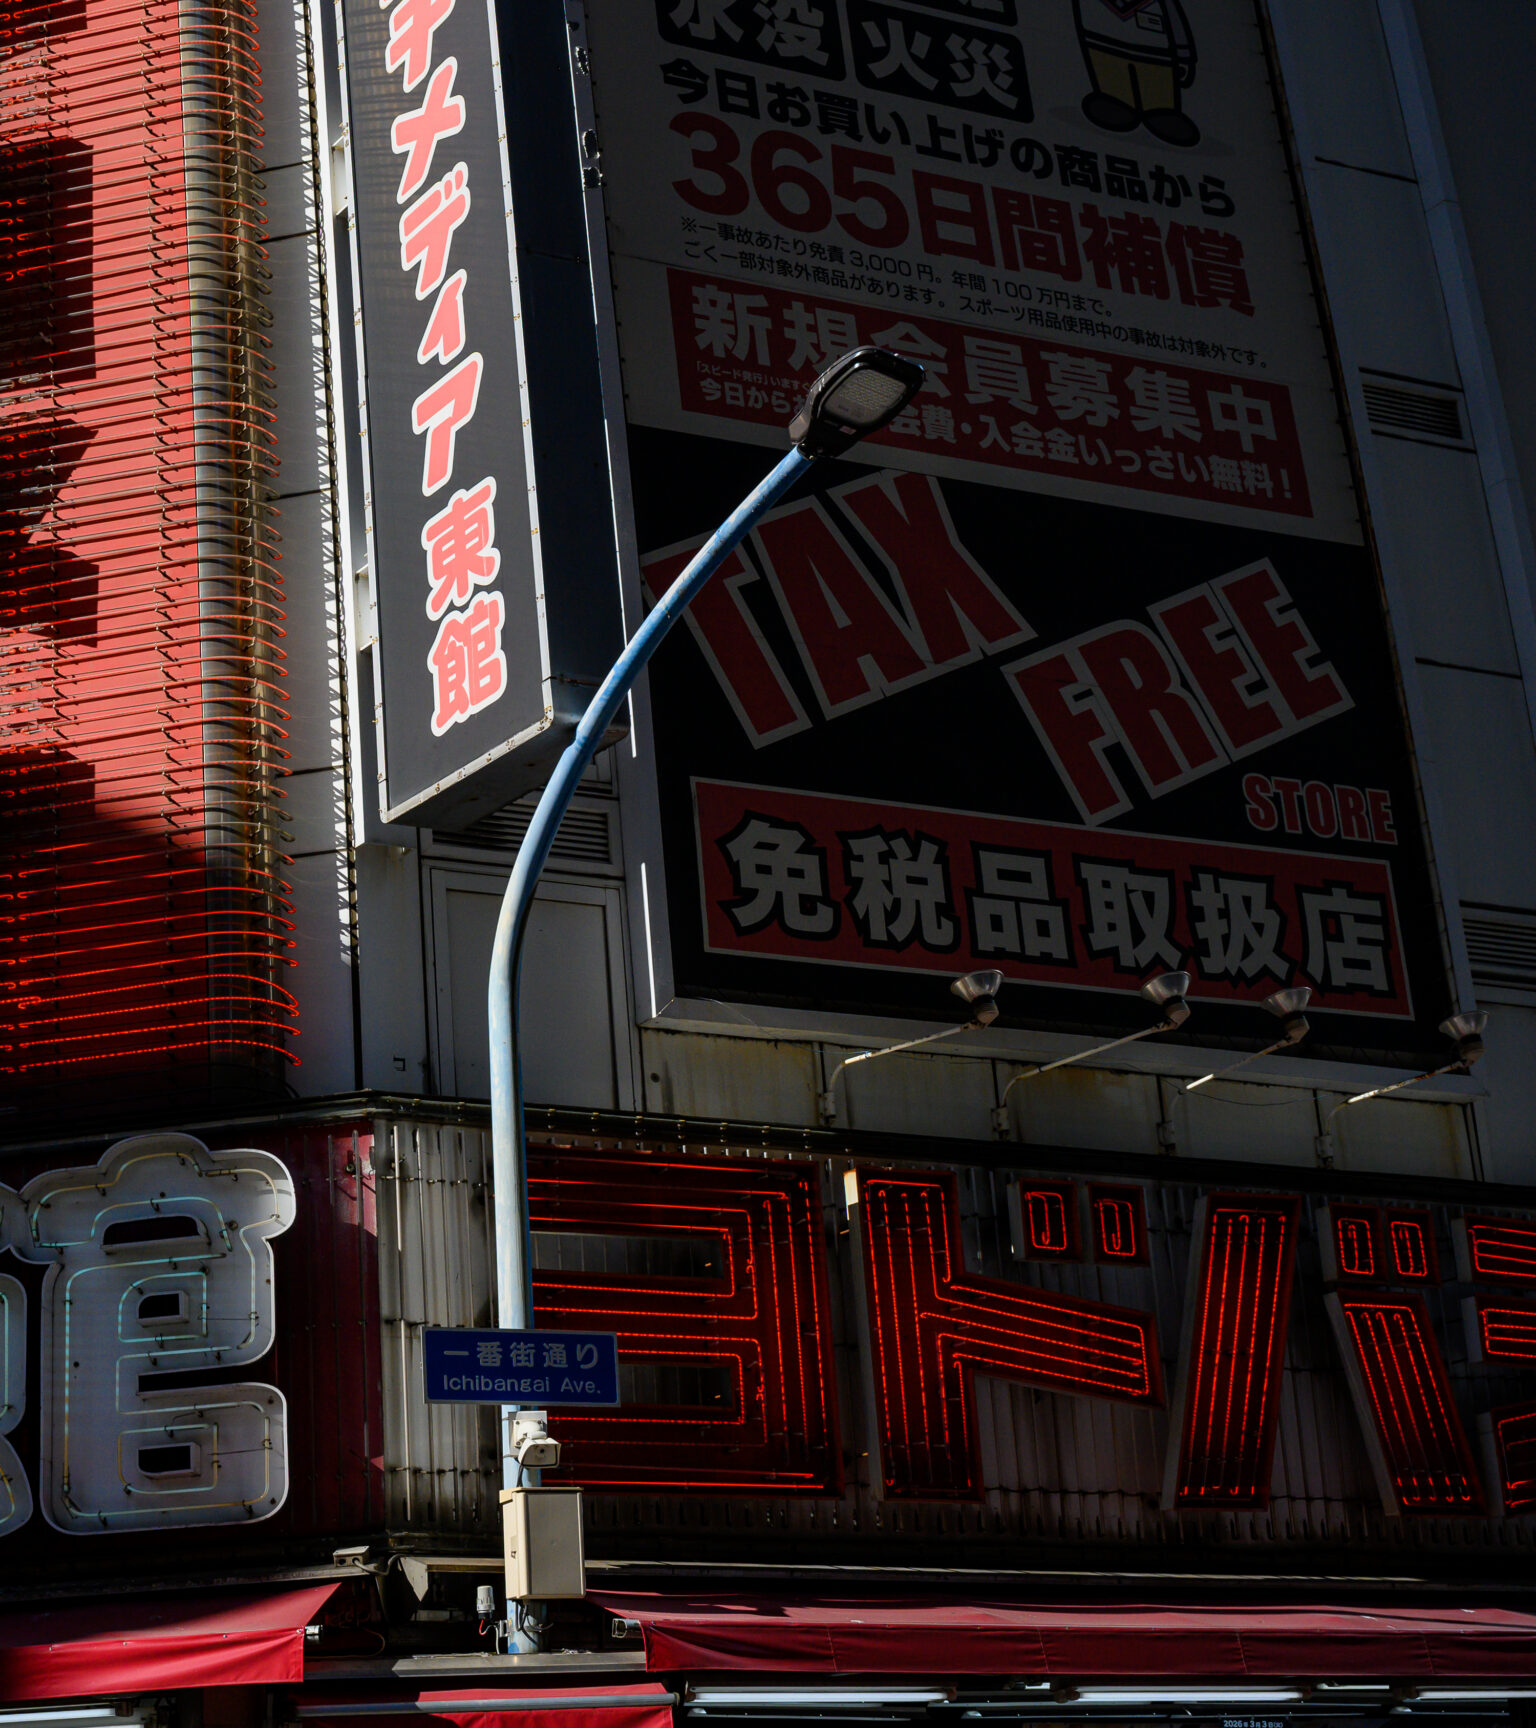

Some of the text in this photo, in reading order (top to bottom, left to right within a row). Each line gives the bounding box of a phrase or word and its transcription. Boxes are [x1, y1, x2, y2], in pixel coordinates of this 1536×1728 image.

[660, 57, 1236, 218] 今日お買い上げの商品から
[860, 18, 1020, 111] 火災
[668, 111, 1256, 318] 365日間補償
[382, 0, 507, 738] チメディア東館
[690, 283, 1278, 454] 新規会員募集中
[640, 469, 1039, 750] TAX
[1001, 556, 1356, 827] FREE
[1241, 773, 1399, 846] STORE
[720, 811, 1396, 997] 免税品取扱店
[442, 1341, 600, 1370] 一番街通り
[443, 1374, 601, 1395] Ichibangai Ave.
